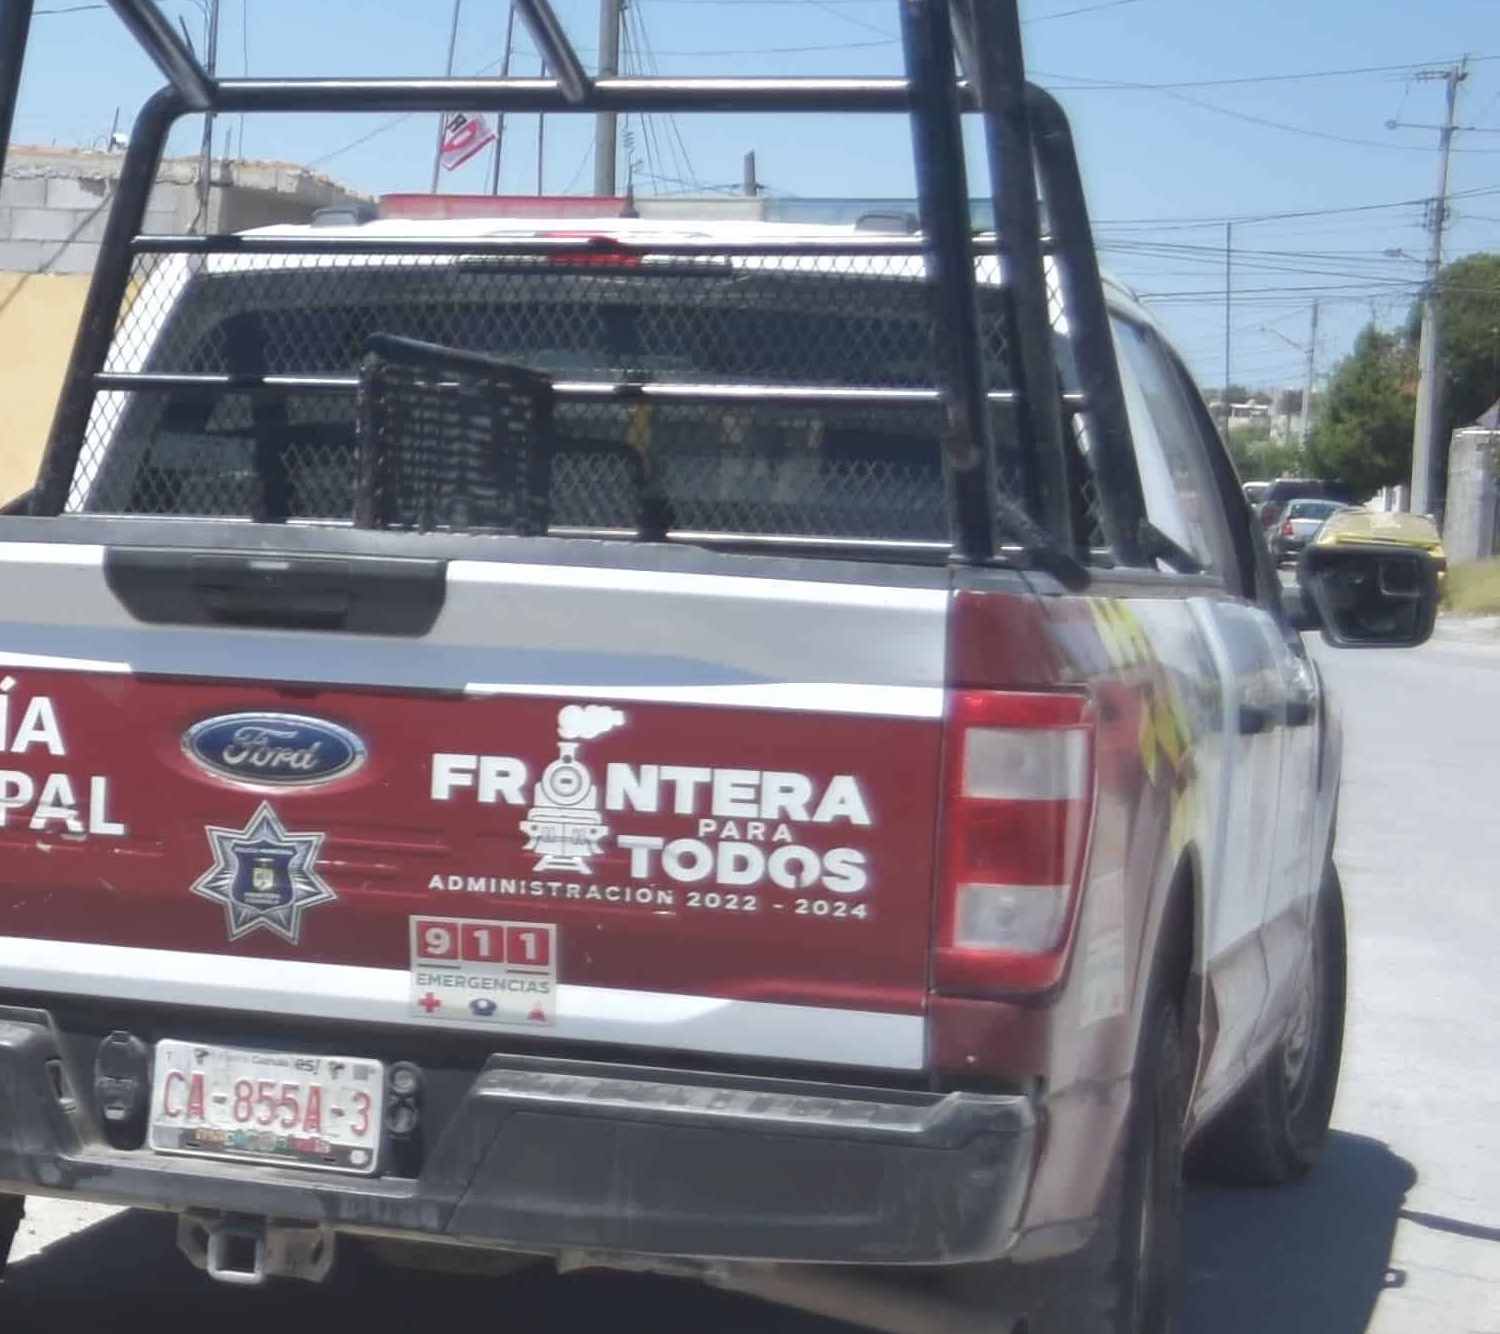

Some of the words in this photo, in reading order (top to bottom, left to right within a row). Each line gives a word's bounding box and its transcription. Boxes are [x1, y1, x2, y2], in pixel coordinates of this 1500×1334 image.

[222, 725, 322, 770] Ford
[698, 818, 794, 843] PARA
[617, 834, 868, 893] TODOS
[686, 892, 758, 912] 2022
[794, 898, 868, 919] 2024
[424, 926, 537, 961] 911
[416, 972, 551, 994] EMERGENCIAS
[163, 1071, 372, 1137] CA-855A-3
